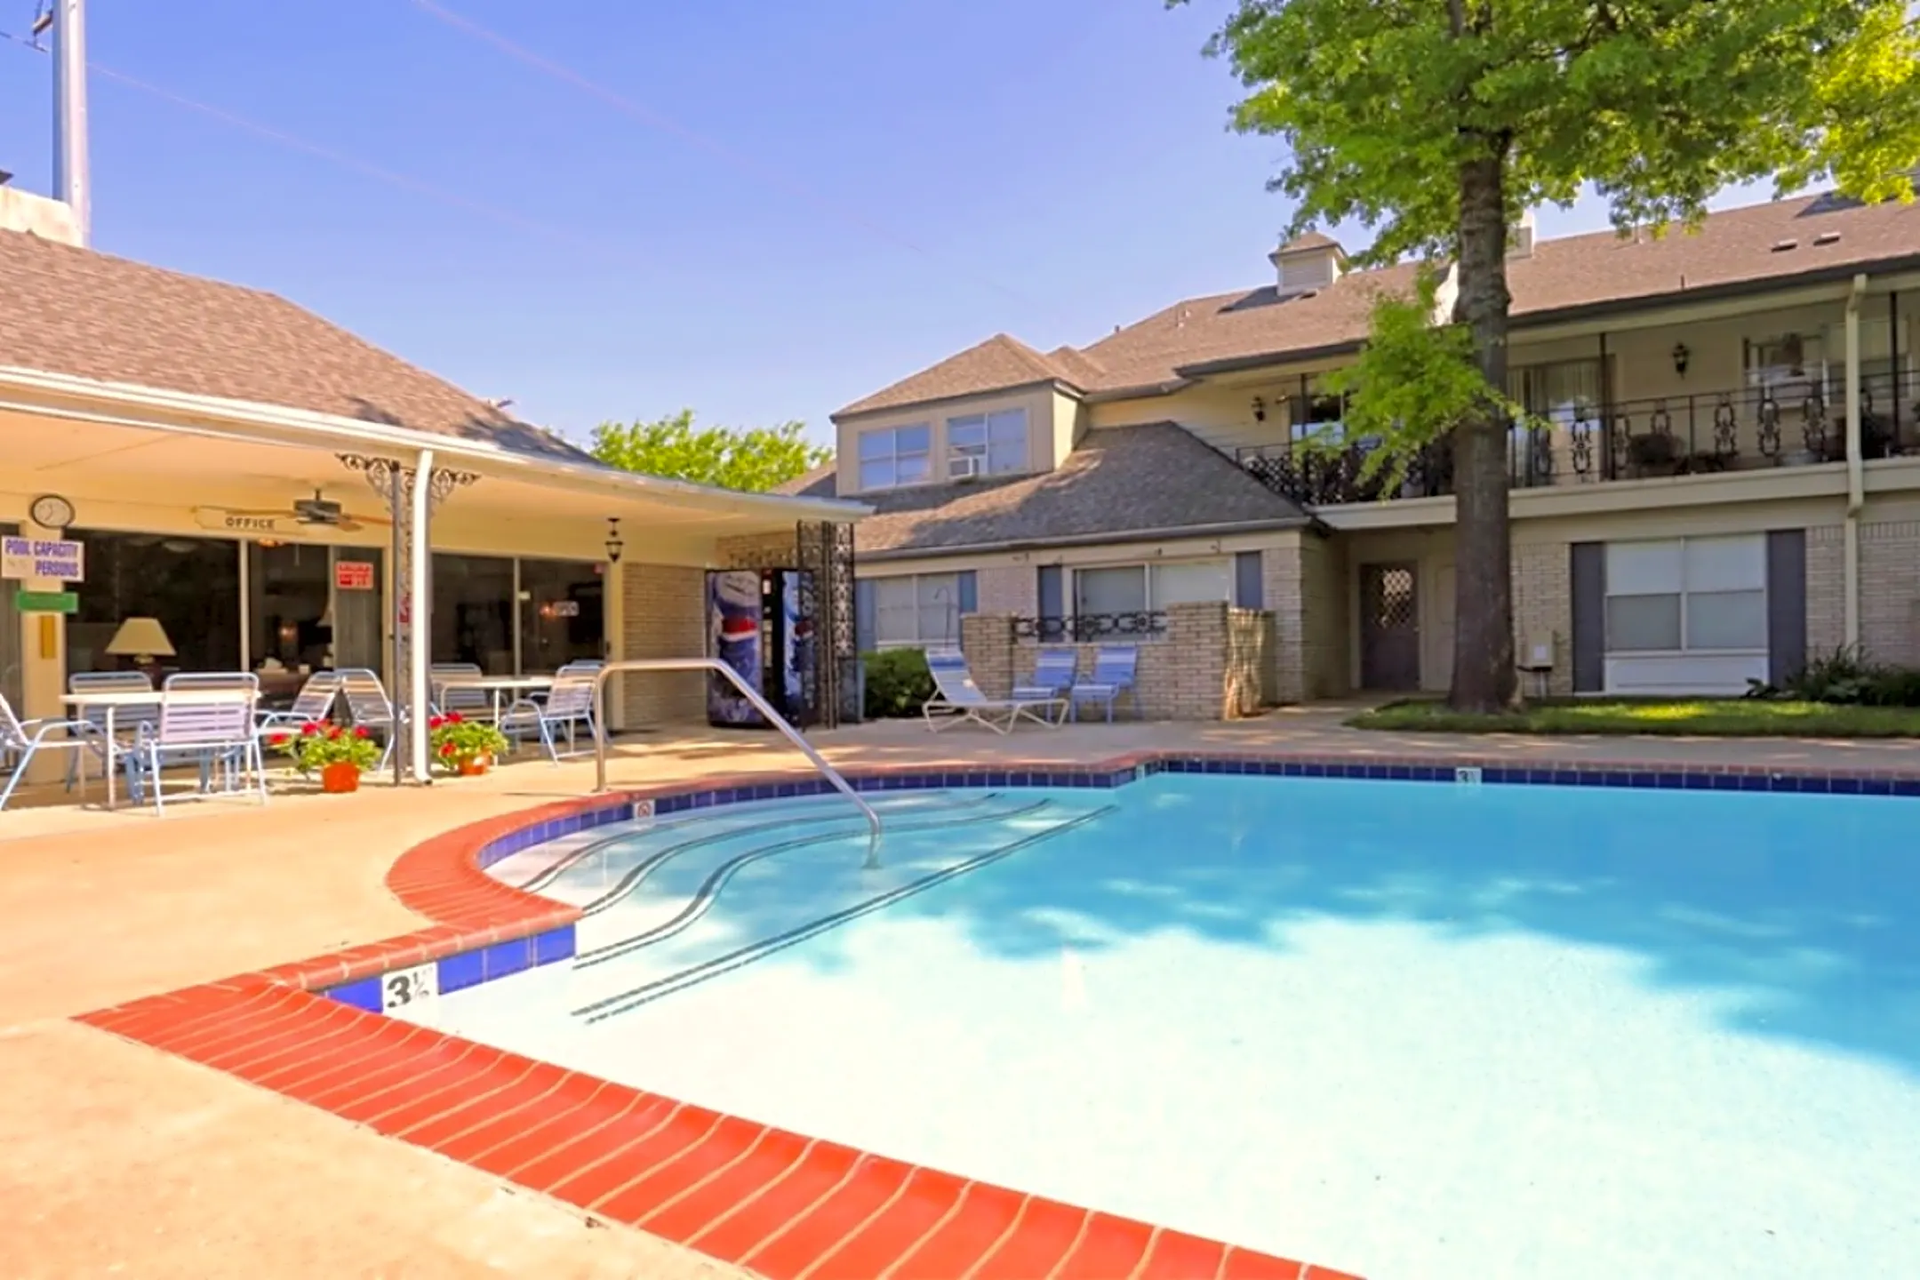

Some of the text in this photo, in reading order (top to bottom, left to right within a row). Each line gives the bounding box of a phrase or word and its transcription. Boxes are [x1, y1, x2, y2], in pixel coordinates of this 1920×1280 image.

[225, 517, 275, 530] OFFICE
[5, 539, 78, 557] POOL CAPACITY
[35, 560, 78, 576] PERSONS
